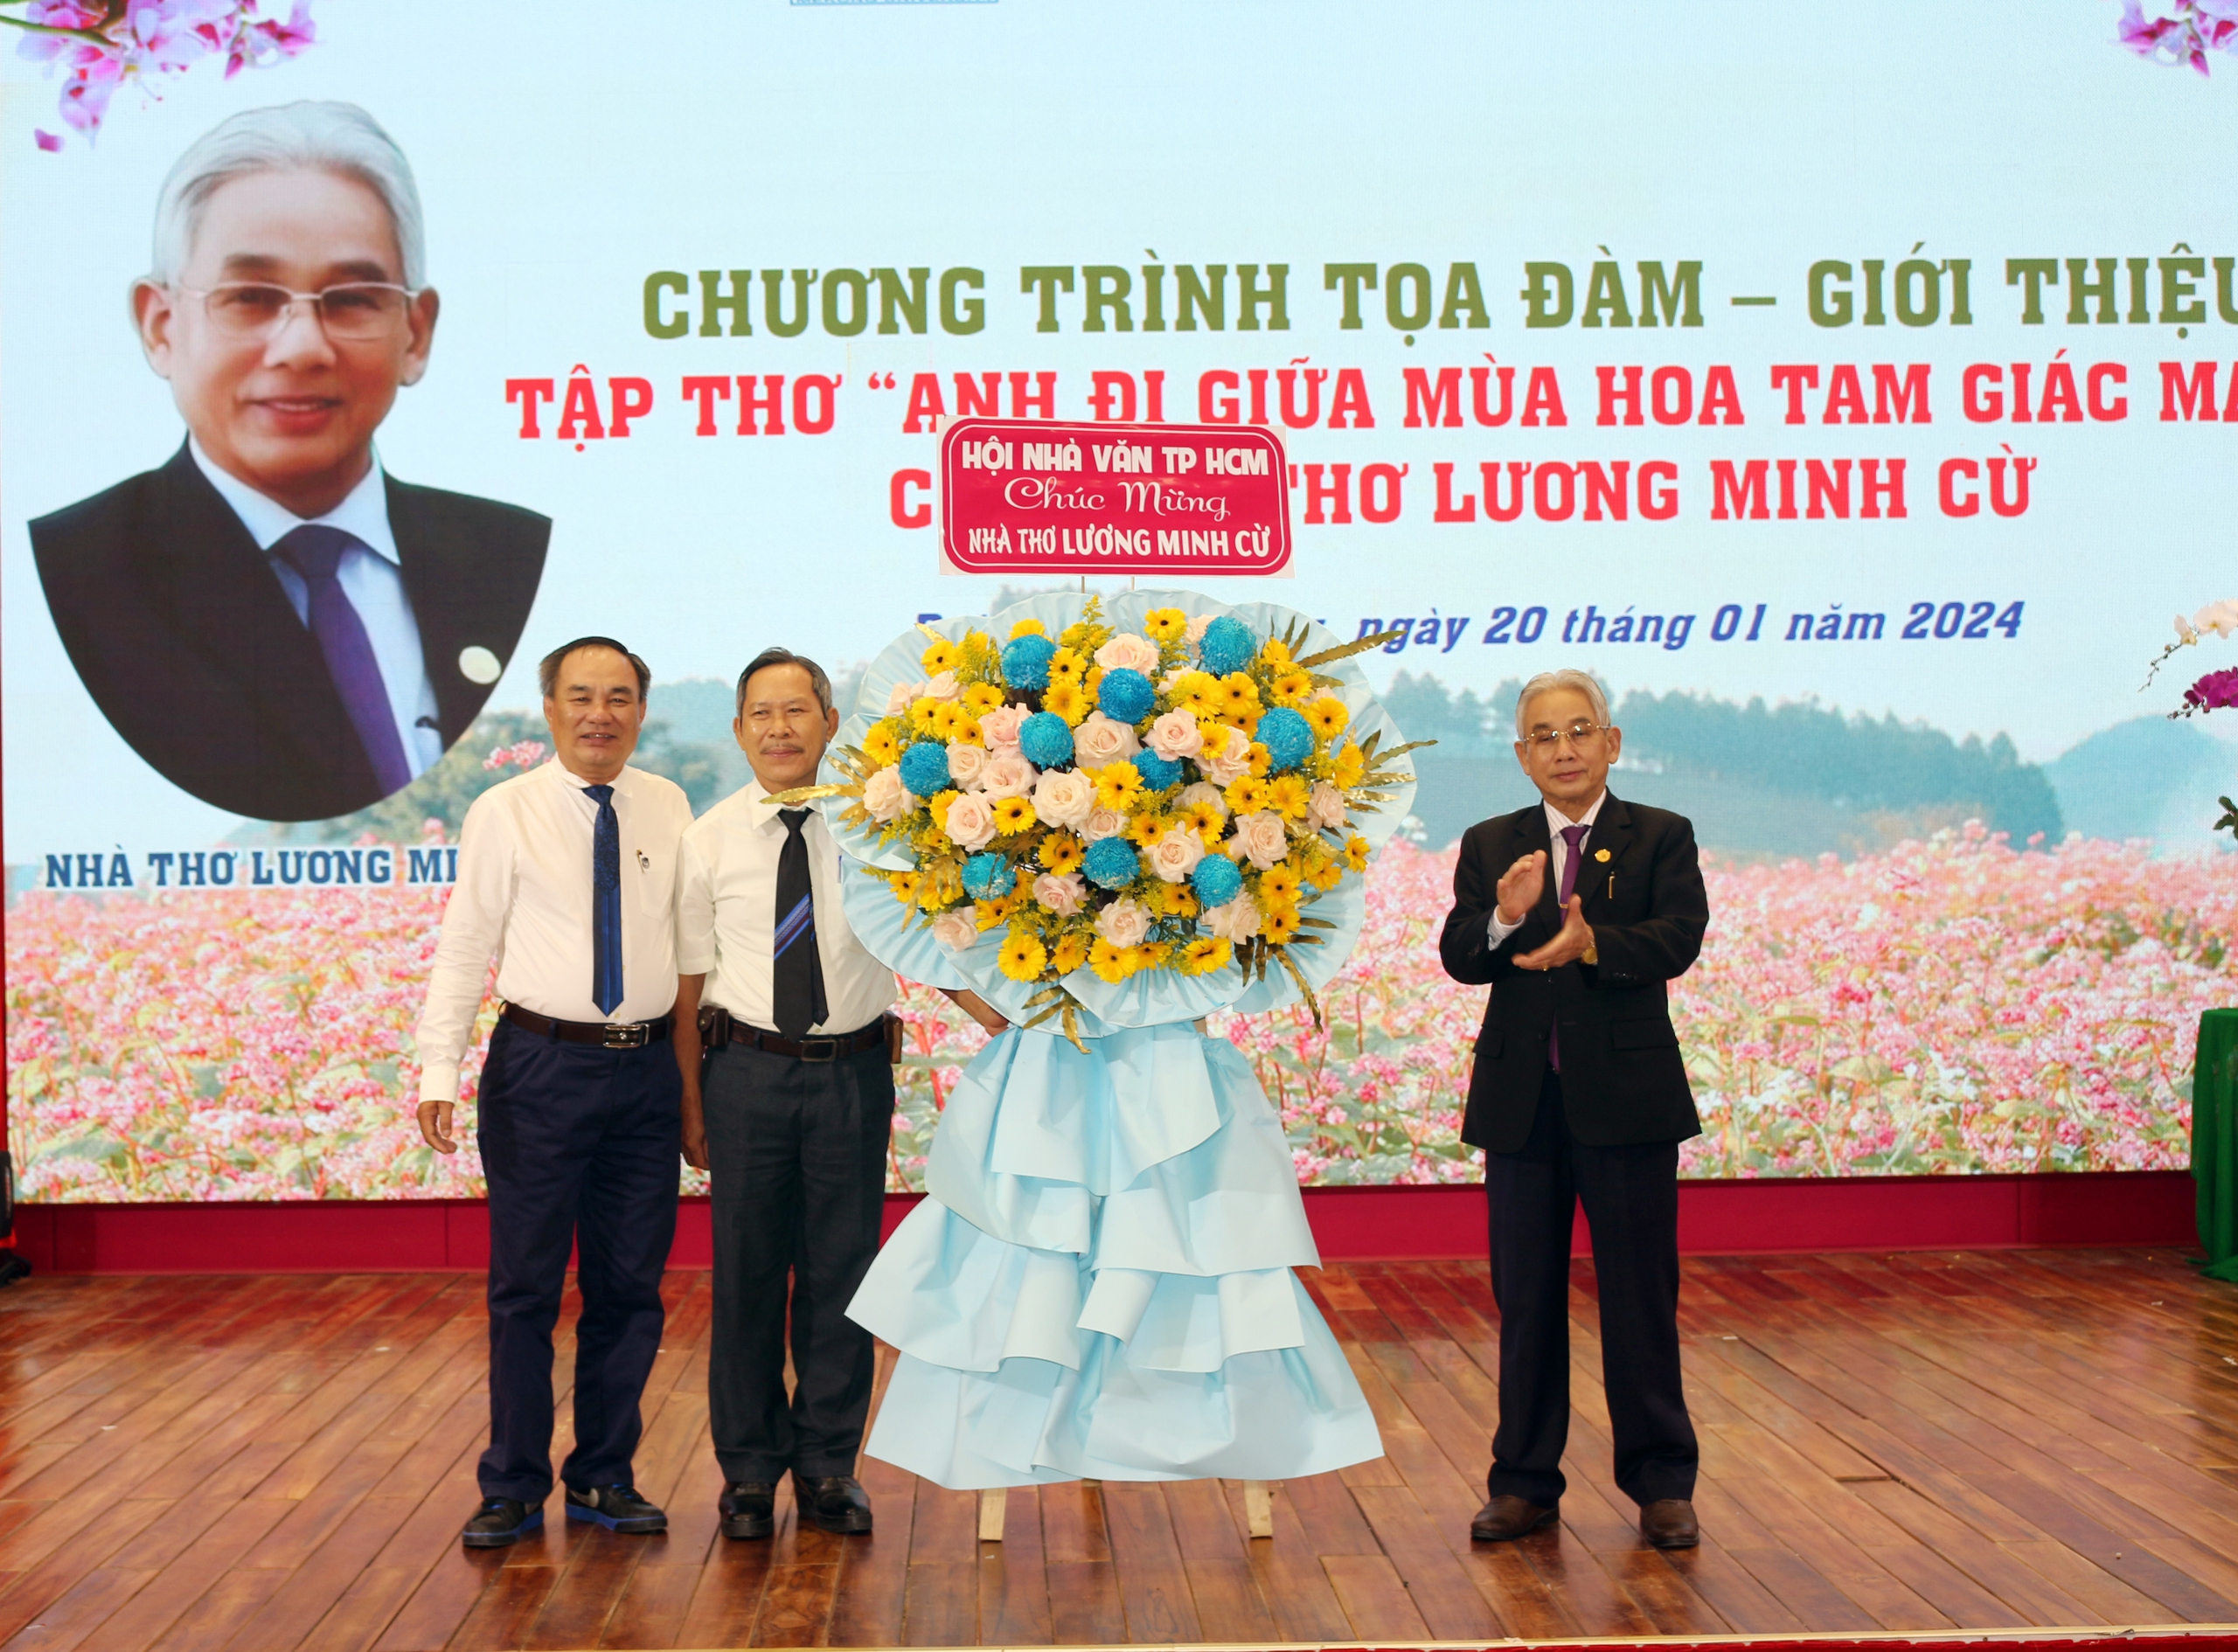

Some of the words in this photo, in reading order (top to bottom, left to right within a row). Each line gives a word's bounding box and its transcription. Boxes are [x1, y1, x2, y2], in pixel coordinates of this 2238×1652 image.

[643, 267, 986, 340] CHƯƠNG
[1020, 249, 1290, 333] TRÌNH
[1324, 262, 1491, 347] TỌA
[1520, 246, 1704, 329] ĐÀM
[1808, 241, 1973, 328] GIỚI
[505, 364, 654, 452] TẬP
[682, 374, 843, 436] THƠ
[1088, 370, 1166, 422] ĐI
[1199, 357, 1375, 430] GIỮA
[1402, 353, 1567, 428] MÙA
[1595, 365, 1746, 427] HOA
[1770, 364, 1932, 425] TAM
[1963, 348, 2129, 423] GIÁC
[962, 435, 1013, 476] HỘI
[1022, 437, 1082, 472] NHÀ
[1092, 439, 1152, 474] VĂN
[1161, 446, 1198, 474] TP
[1205, 447, 1269, 475] HCM
[1004, 475, 1106, 510] Chúc
[1116, 481, 1231, 523] Mừng
[1289, 462, 1409, 524] HƠ
[1433, 460, 1679, 523] LƯƠNG
[1710, 458, 1908, 520] MINH
[1938, 443, 2038, 518] CỪ
[968, 522, 1013, 554] NHÀ
[1016, 524, 1057, 554] THƠ
[1061, 522, 1151, 557] LƯƠNG
[1157, 529, 1230, 557] MINH
[1234, 523, 1271, 558] CỪ
[1357, 607, 1470, 654] ngày
[1484, 606, 1548, 644] 20
[1561, 605, 1696, 651] tháng
[1711, 604, 1767, 642] 01
[1785, 603, 1886, 641] năm
[1901, 600, 2025, 640] 2024
[45, 843, 133, 887] NHÀ
[148, 850, 238, 886] THƠ
[252, 849, 391, 885] LƯƠNG
[408, 848, 458, 883] MI
